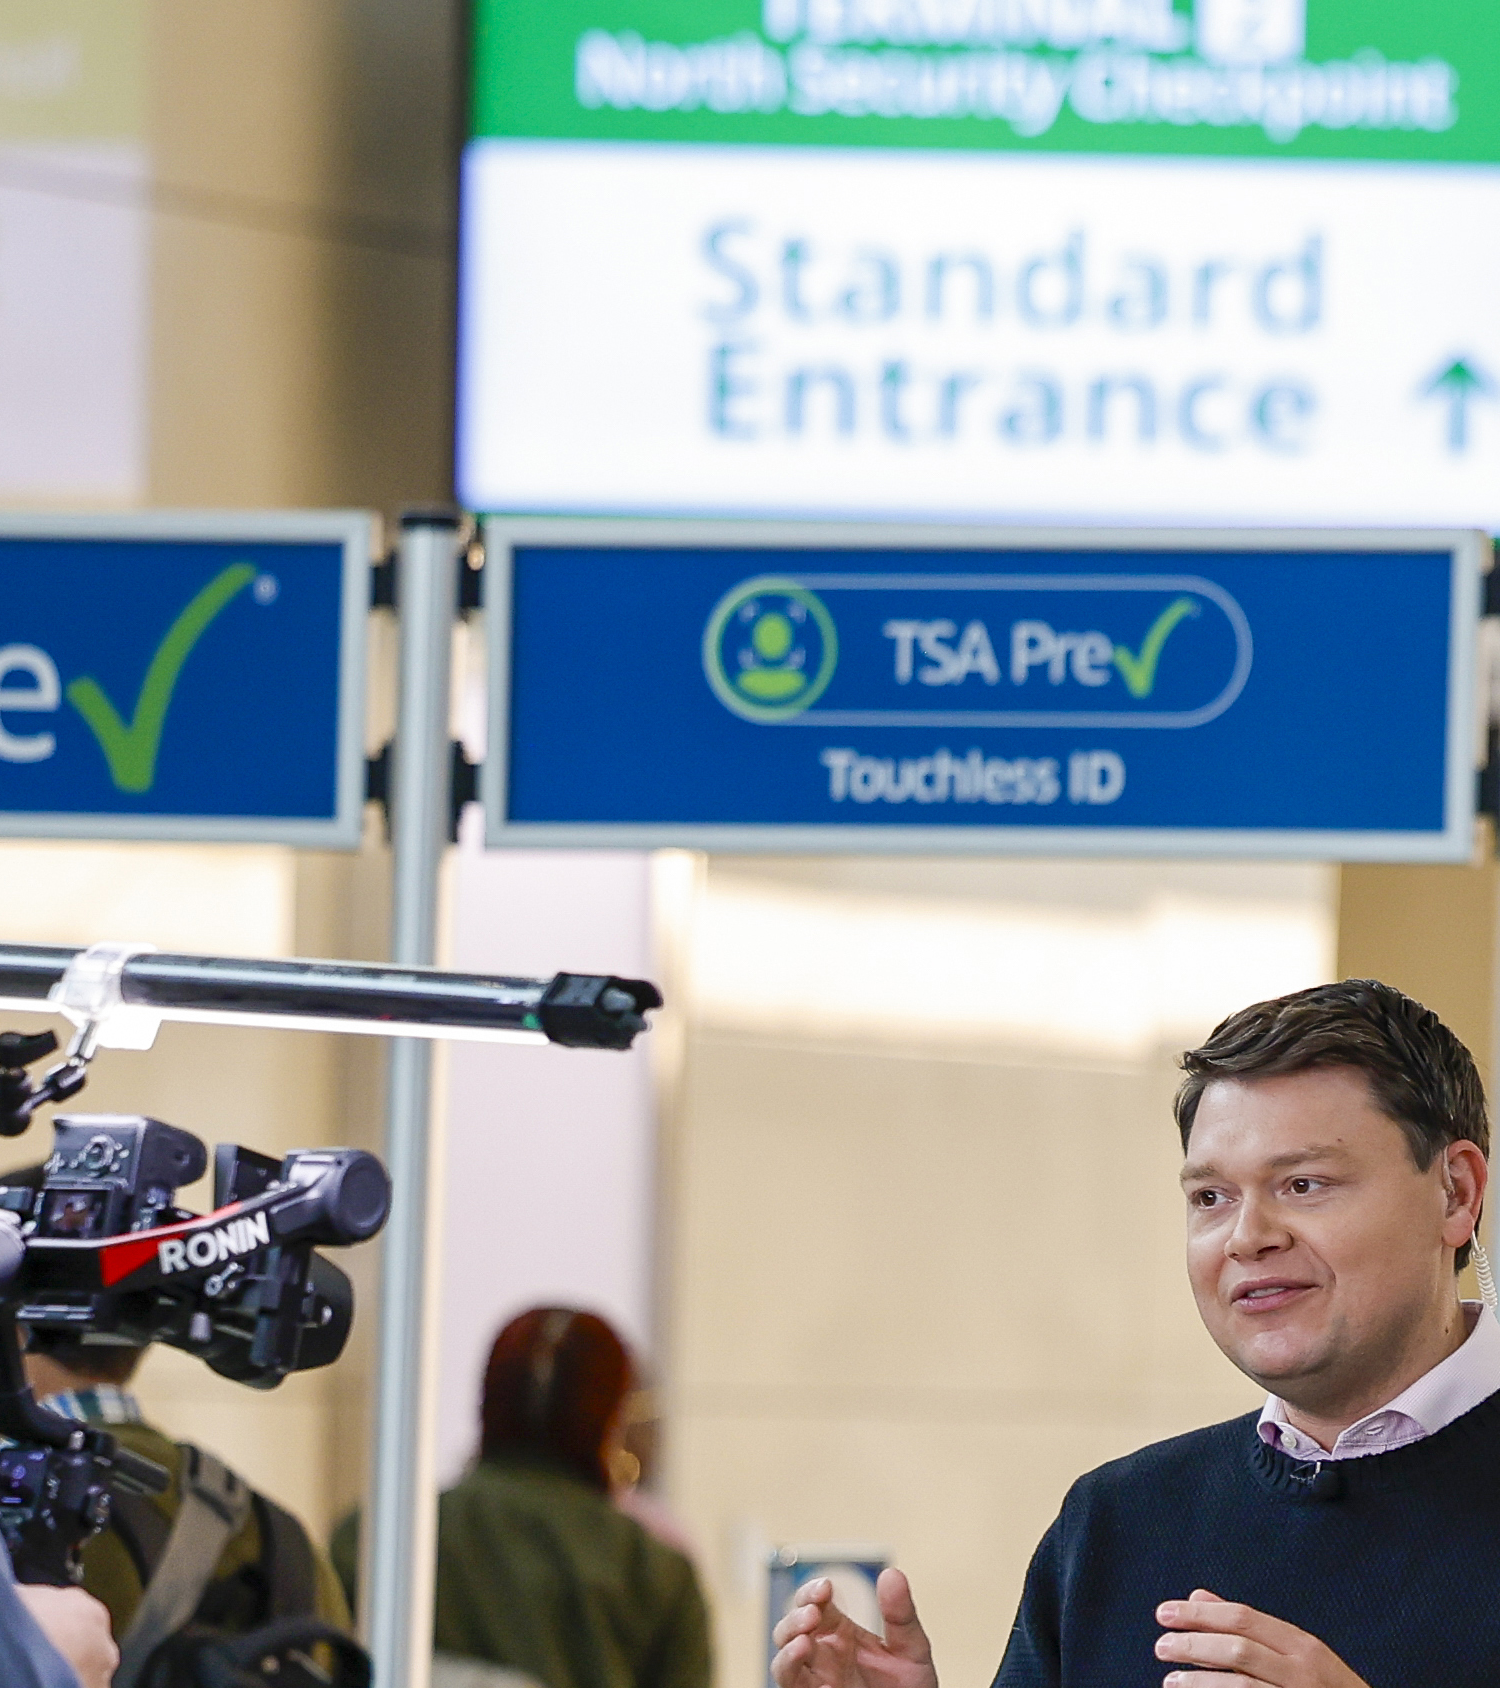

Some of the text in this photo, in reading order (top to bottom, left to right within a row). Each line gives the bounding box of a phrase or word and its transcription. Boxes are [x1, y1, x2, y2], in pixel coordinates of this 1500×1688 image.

[577, 31, 1457, 143] North Security Checkpoint
[699, 218, 1325, 334] Standard
[708, 340, 1320, 454] Entrance
[884, 619, 1000, 686] TSA
[820, 747, 1127, 805] Touchless ID
[158, 1210, 270, 1275] RONIN
